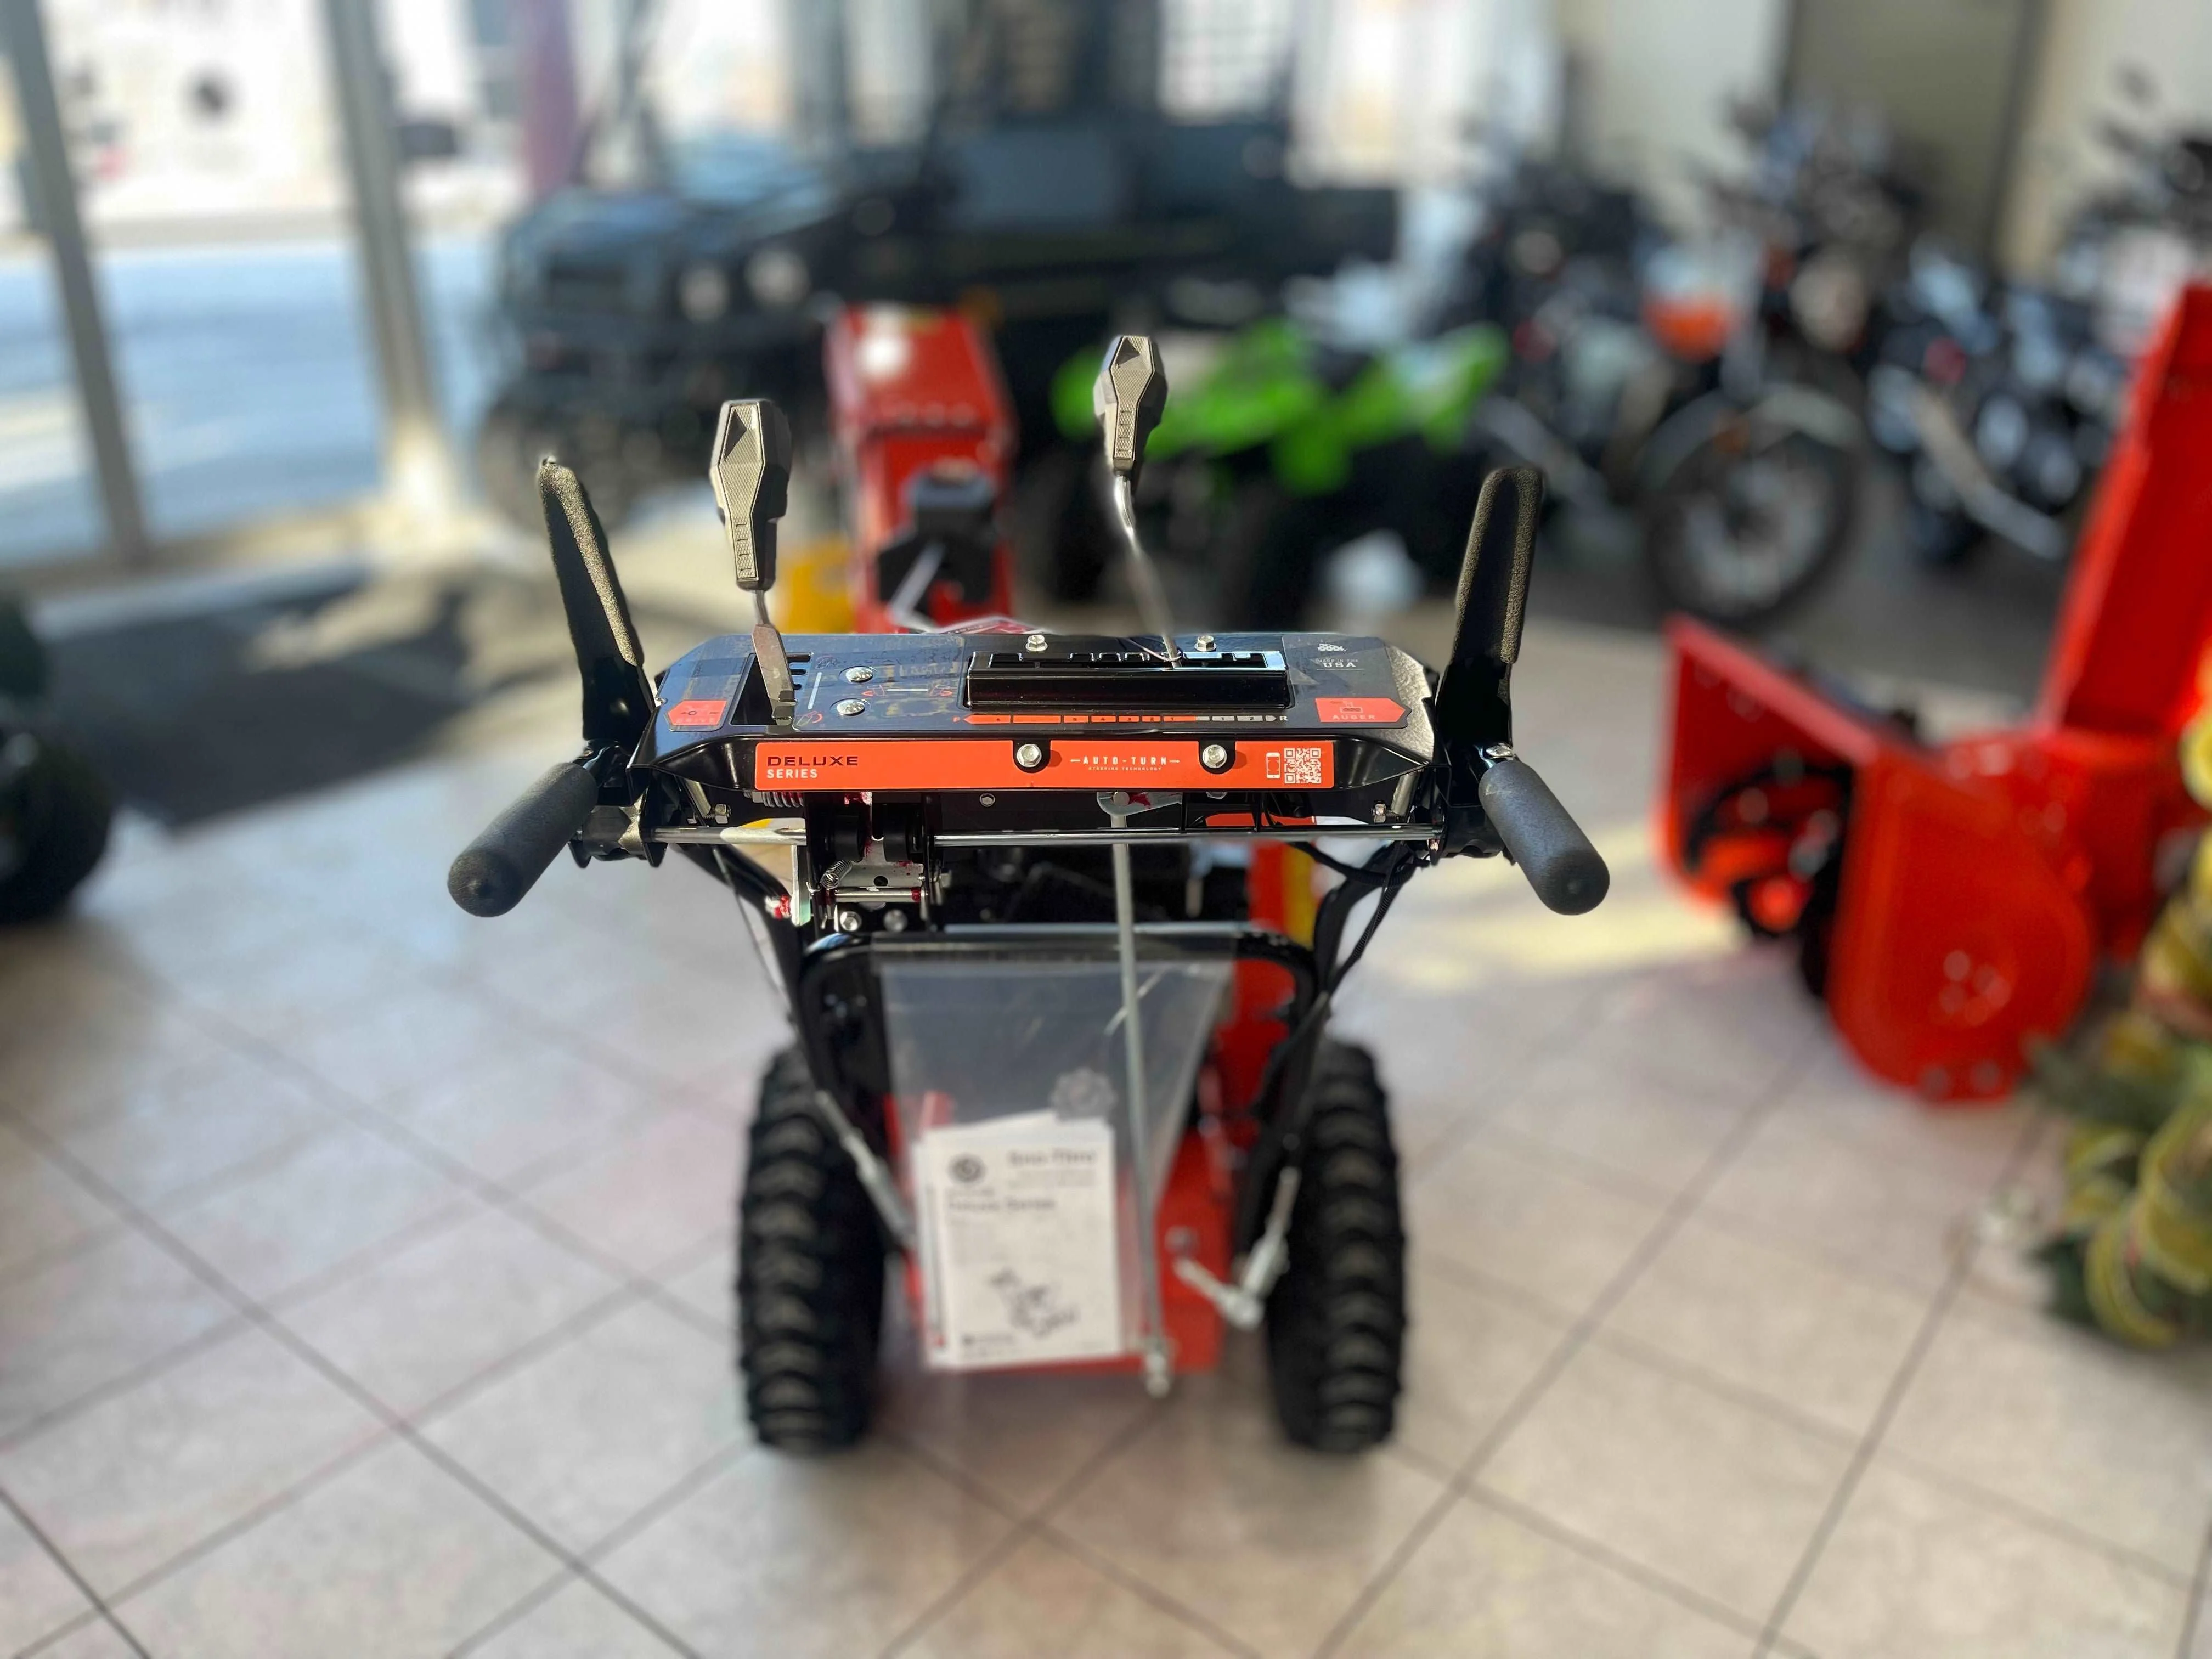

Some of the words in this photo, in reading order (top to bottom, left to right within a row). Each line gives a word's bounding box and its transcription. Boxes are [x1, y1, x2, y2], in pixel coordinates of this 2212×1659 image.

[768, 756, 858, 766] DELUXE
[1083, 756, 1167, 765] AUTO-TURN
[766, 769, 818, 778] SERIES
